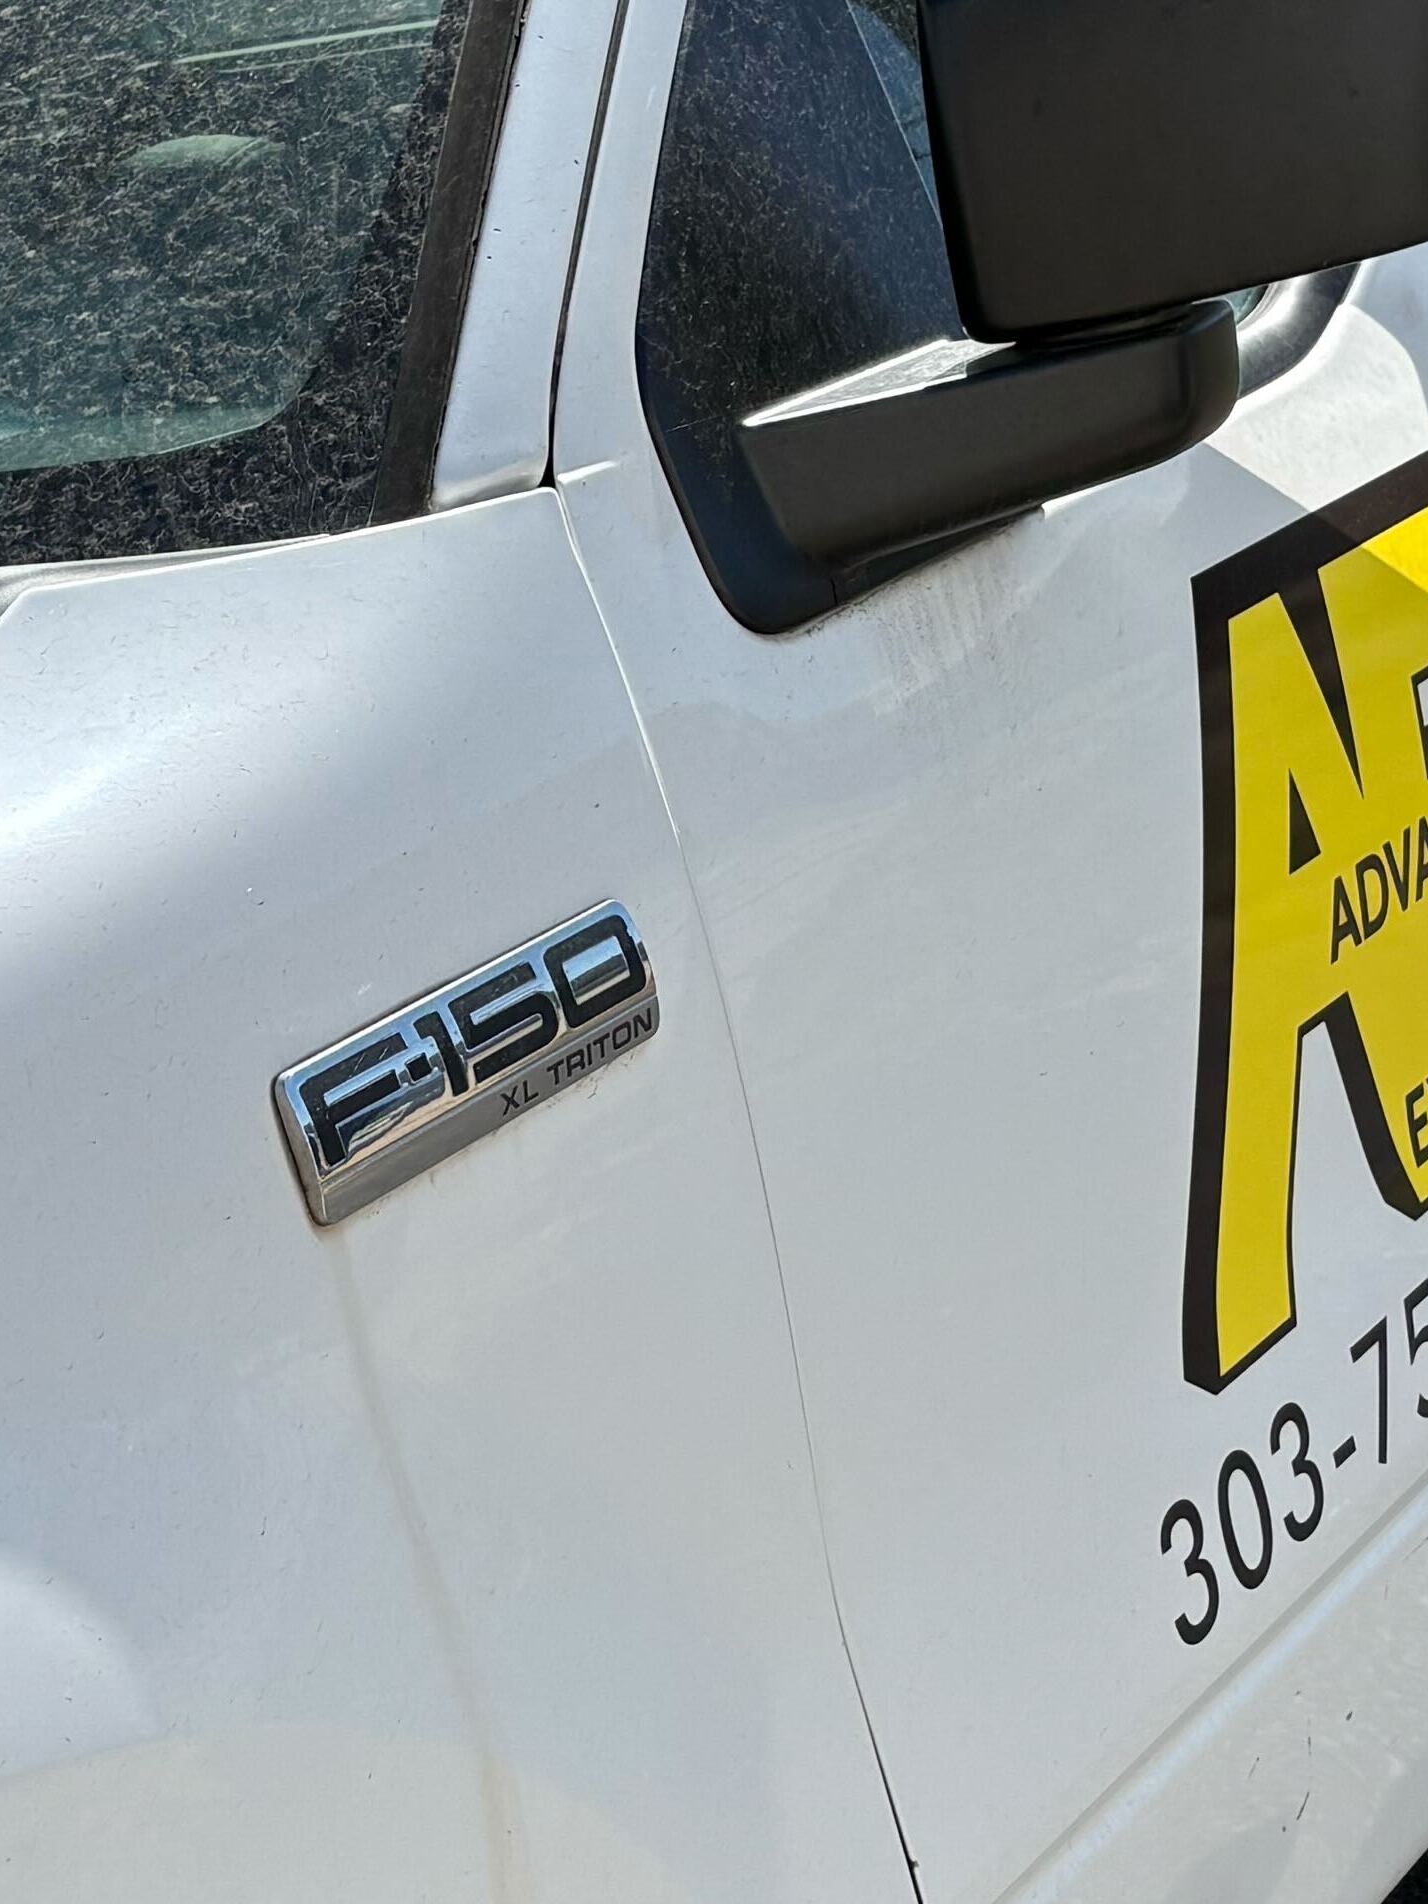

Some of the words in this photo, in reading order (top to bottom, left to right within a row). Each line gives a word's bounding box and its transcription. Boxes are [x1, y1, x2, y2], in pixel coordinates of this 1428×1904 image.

[298, 914, 648, 1168] F-150
[500, 1078, 540, 1117] XL
[546, 1007, 654, 1088] TRITON
